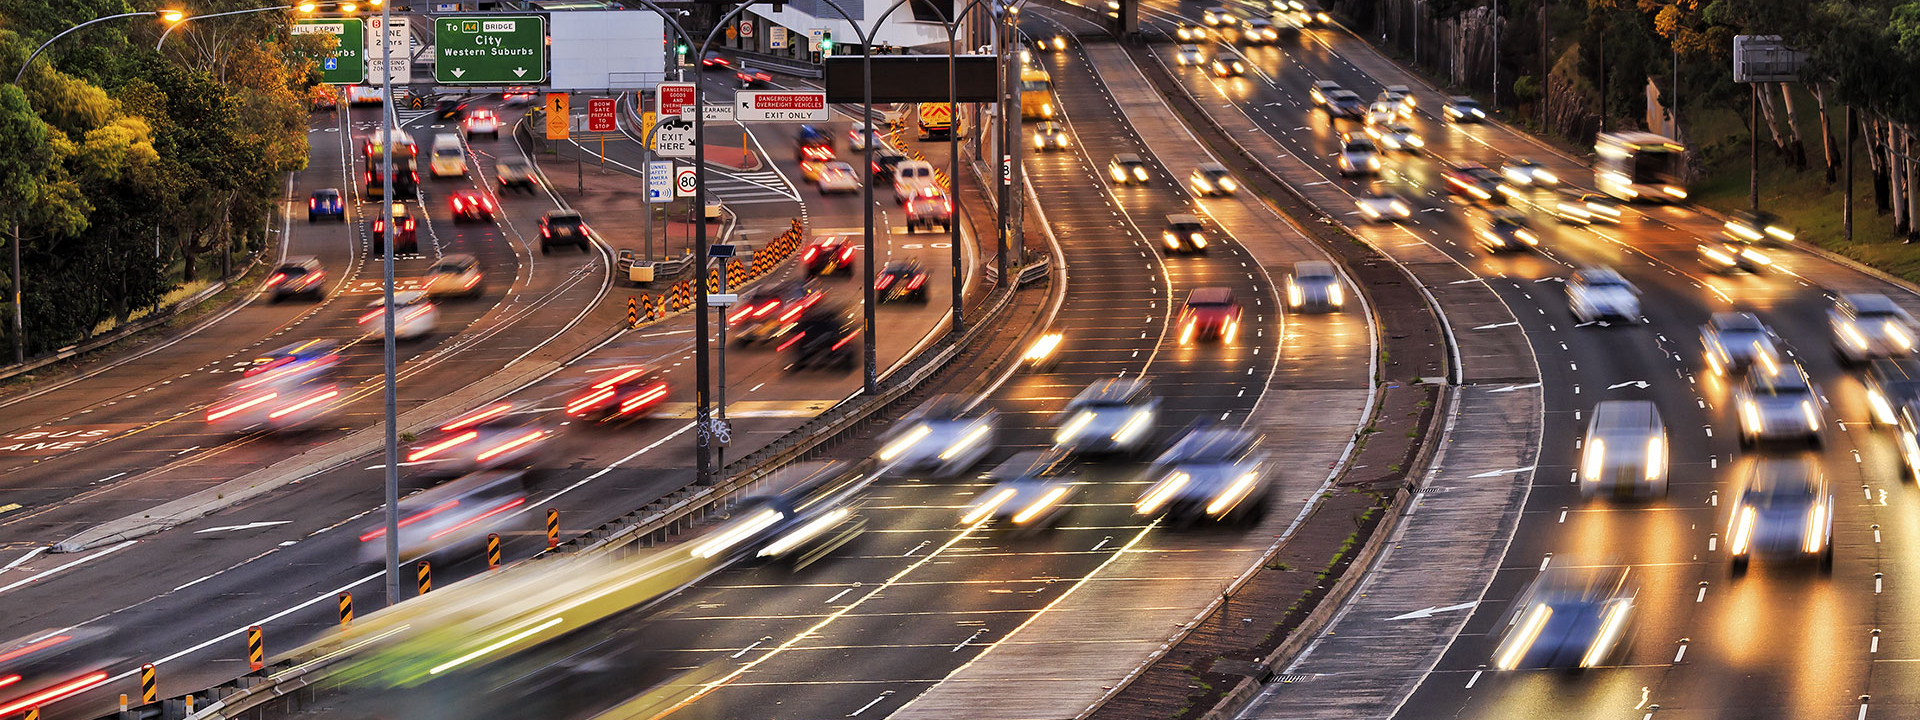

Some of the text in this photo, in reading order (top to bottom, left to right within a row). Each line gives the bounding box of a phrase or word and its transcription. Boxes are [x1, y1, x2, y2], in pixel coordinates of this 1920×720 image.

[446, 23, 458, 31] To
[464, 23, 476, 31] A4
[475, 35, 502, 47] City
[444, 48, 486, 56] Western
[491, 47, 534, 56] Suburbs
[661, 133, 683, 141] EXIT
[659, 142, 685, 150] HERE
[680, 176, 697, 187] 80
[13, 430, 110, 440] BUS
[0, 441, 88, 451] ANE
